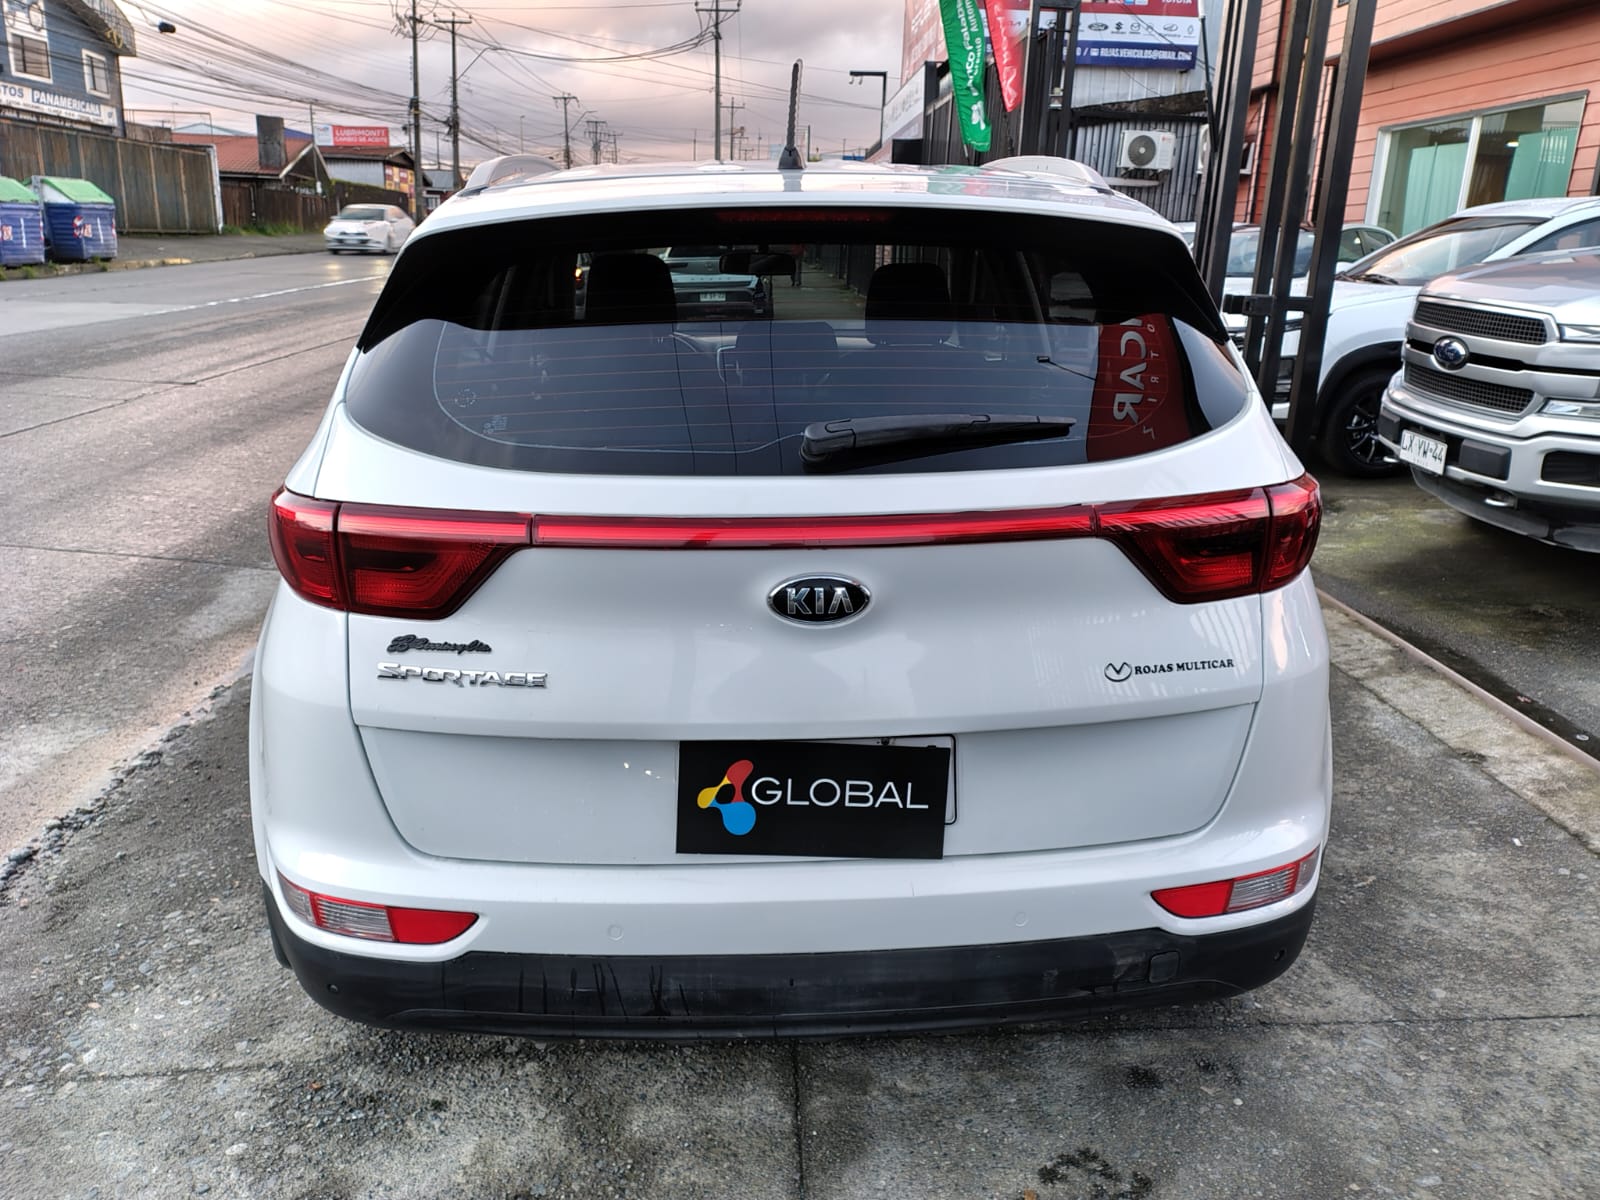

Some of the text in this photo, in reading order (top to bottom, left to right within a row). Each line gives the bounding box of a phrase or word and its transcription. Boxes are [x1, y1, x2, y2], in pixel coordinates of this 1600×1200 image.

[0, 84, 24, 98] TOS
[33, 90, 101, 116] PANAMERICANA
[785, 587, 854, 615] KIA
[377, 661, 548, 689] SPORTAGE
[1134, 659, 1235, 675] ROJAS MULTICAR
[751, 776, 929, 809] GLOBAL
